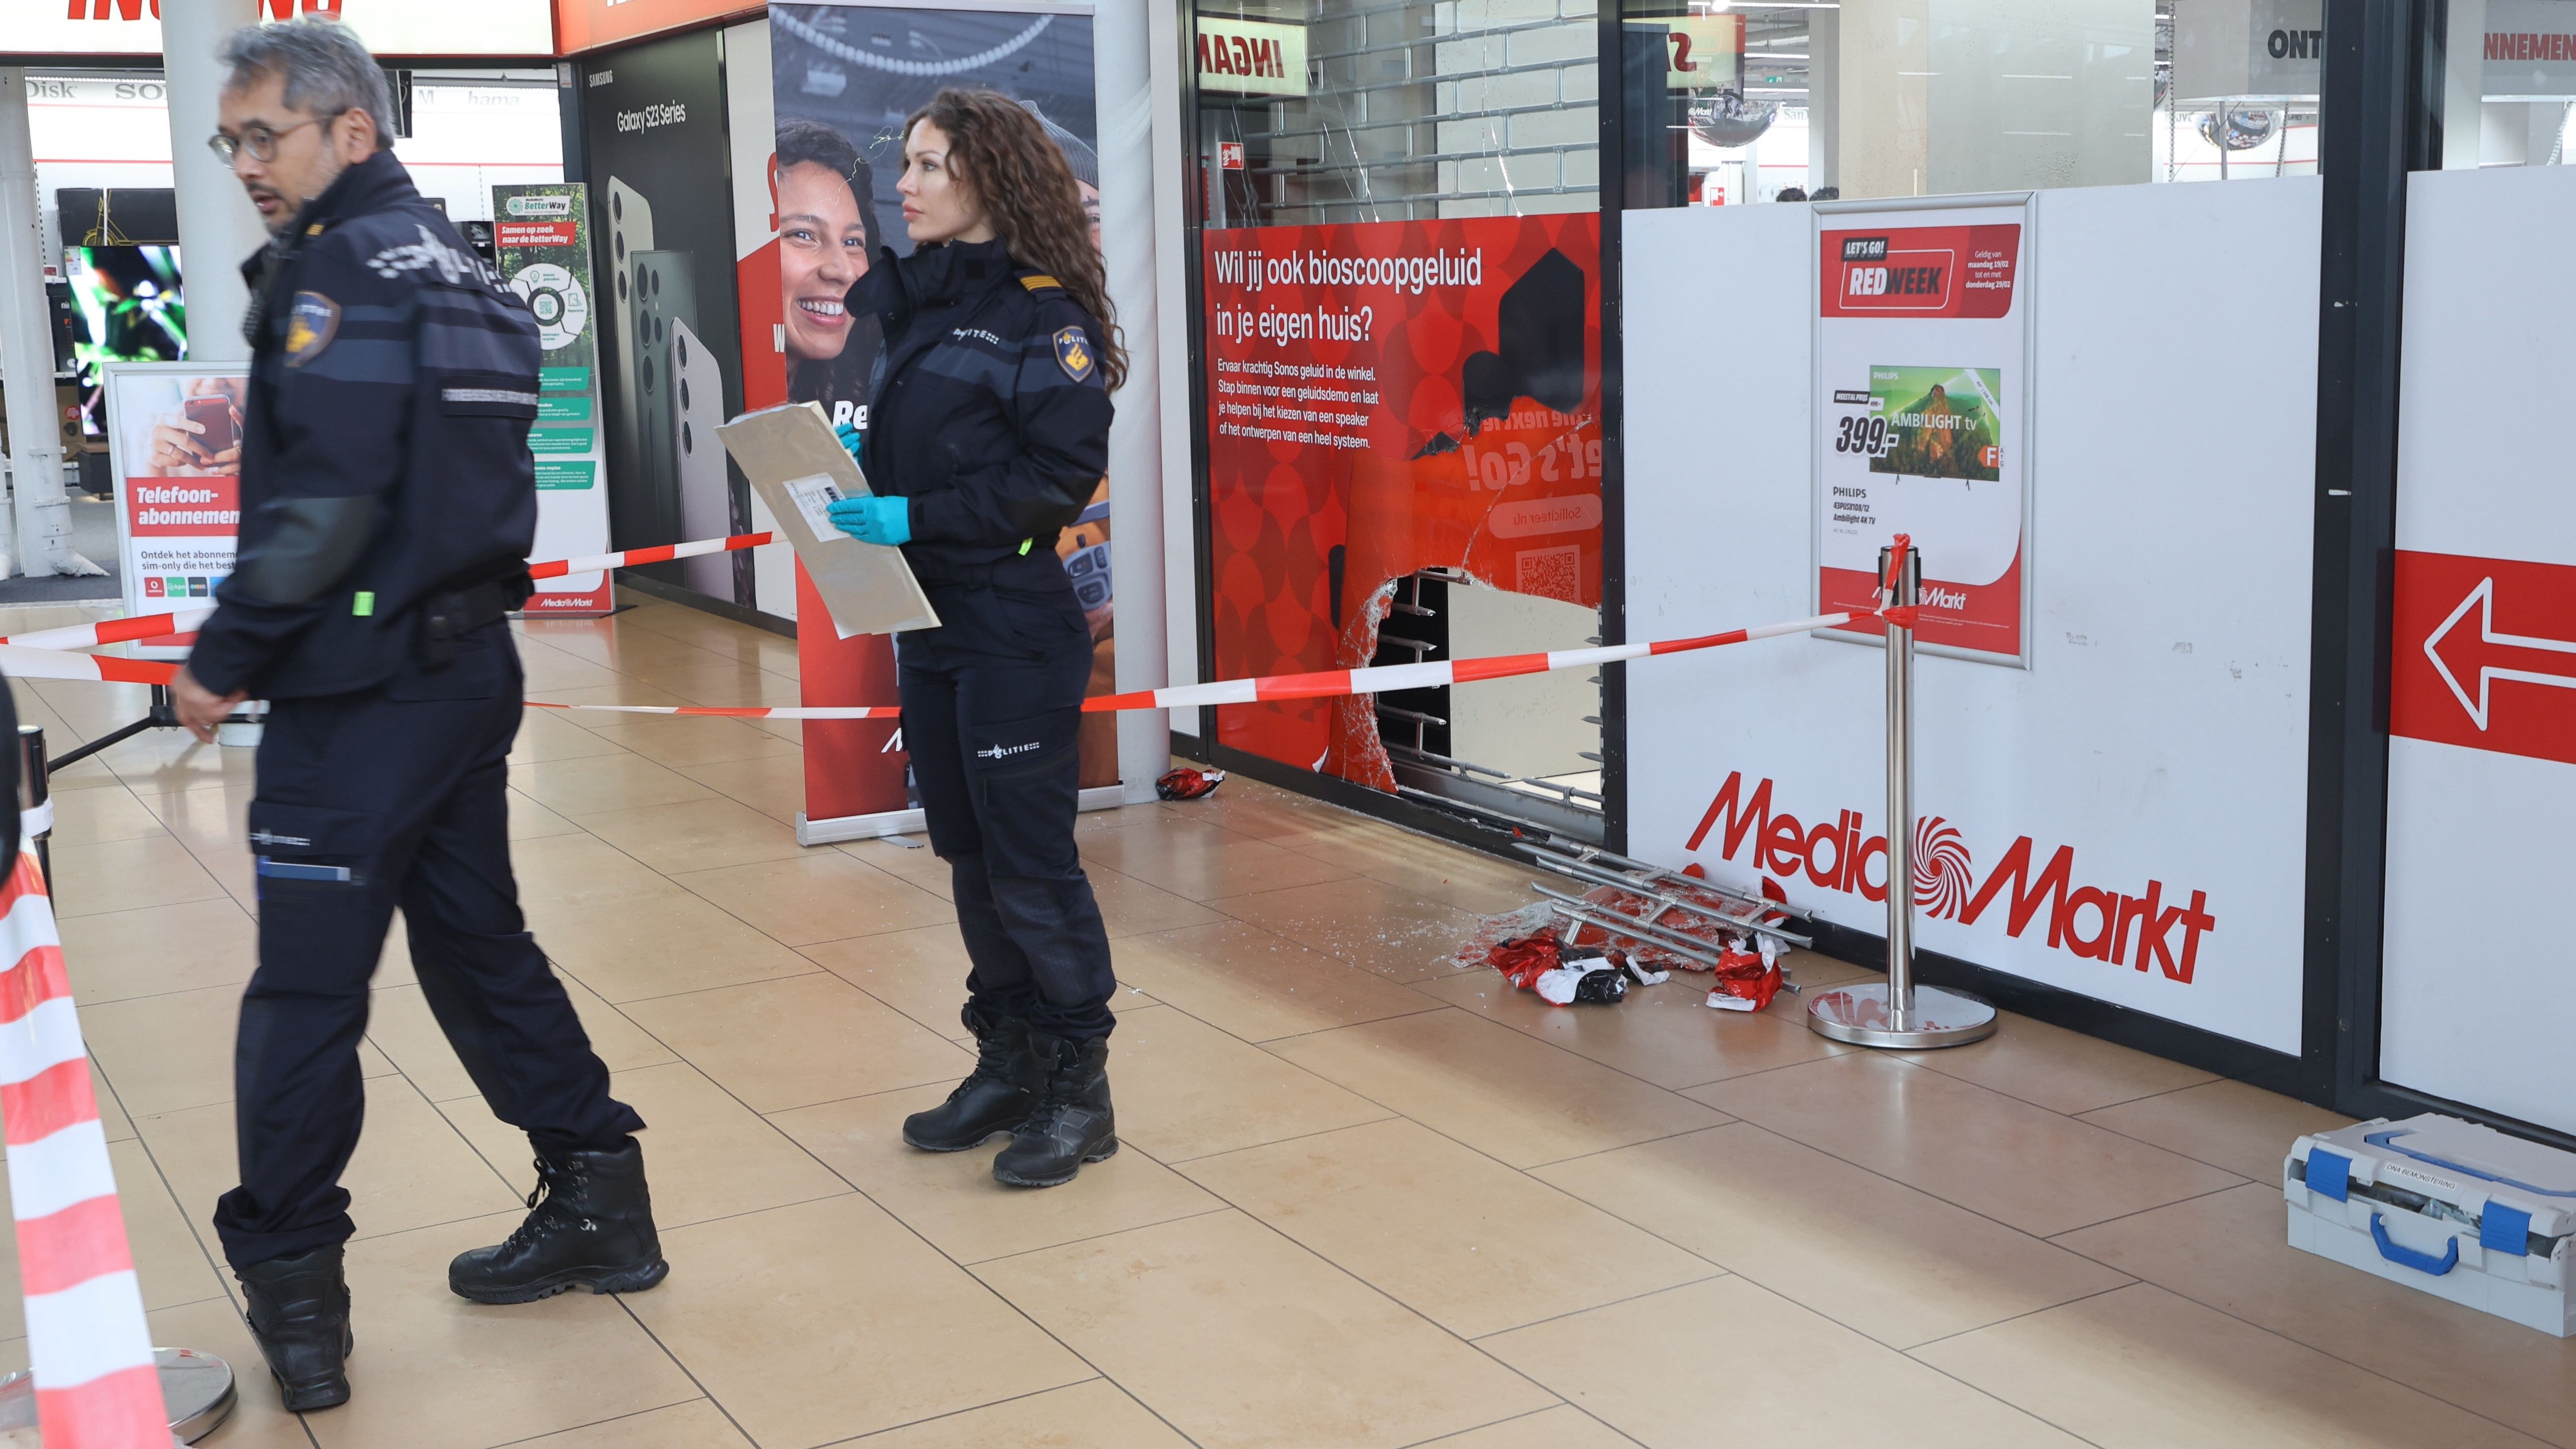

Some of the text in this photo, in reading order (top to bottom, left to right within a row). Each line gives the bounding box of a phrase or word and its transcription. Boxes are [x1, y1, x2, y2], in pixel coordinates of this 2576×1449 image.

[2268, 29, 2321, 59] ONT
[589, 70, 613, 87] SAMSUNG
[115, 83, 167, 99] SO
[468, 91, 519, 106] hama
[617, 99, 686, 134] Galaxy S23 Series
[525, 201, 566, 211] BetterWay
[502, 226, 525, 234] Samen
[537, 225, 554, 234] zoek
[530, 235, 568, 244] BetterWay
[1846, 241, 1885, 255] LET'S GO!
[1975, 251, 1991, 259] Geldig
[1214, 247, 1481, 295] Wil jij ook bioscoopgeluid
[1965, 281, 1995, 289] donderdag
[1217, 303, 1373, 347] in je eigen huis?
[1218, 358, 1375, 381] Ervaar krachtig Sonos geluid in de winkel.
[1873, 372, 1899, 380] PHILIPS
[1218, 379, 1379, 404] Stap binnen voor een geluidsdemo en laat
[1836, 393, 1869, 402] MEESTAL PRIJS
[832, 400, 868, 429] Re
[1218, 400, 1369, 427] je helpen bij het kiezen van een speaker
[1964, 418, 1977, 431] tv
[1219, 422, 1370, 450] of het ontwerpen van een heel systeem.
[1836, 416, 1899, 457] 399.-
[1986, 447, 1997, 466] F
[137, 486, 218, 504] Telefoon-
[1833, 486, 1866, 499] PHILIPS
[1834, 502, 1869, 512] 43PUS8108/12
[138, 508, 240, 525] abonnemen
[1833, 513, 1860, 524] Ambilight
[141, 551, 173, 559] Ontdek
[193, 551, 236, 559] abonnem
[142, 562, 180, 571] sim-only
[540, 598, 593, 607] Media Markt
[1927, 587, 1965, 610] Markt
[1958, 835, 2215, 984] Markt
[2386, 1164, 2456, 1189] DNA BEMONSTERING
